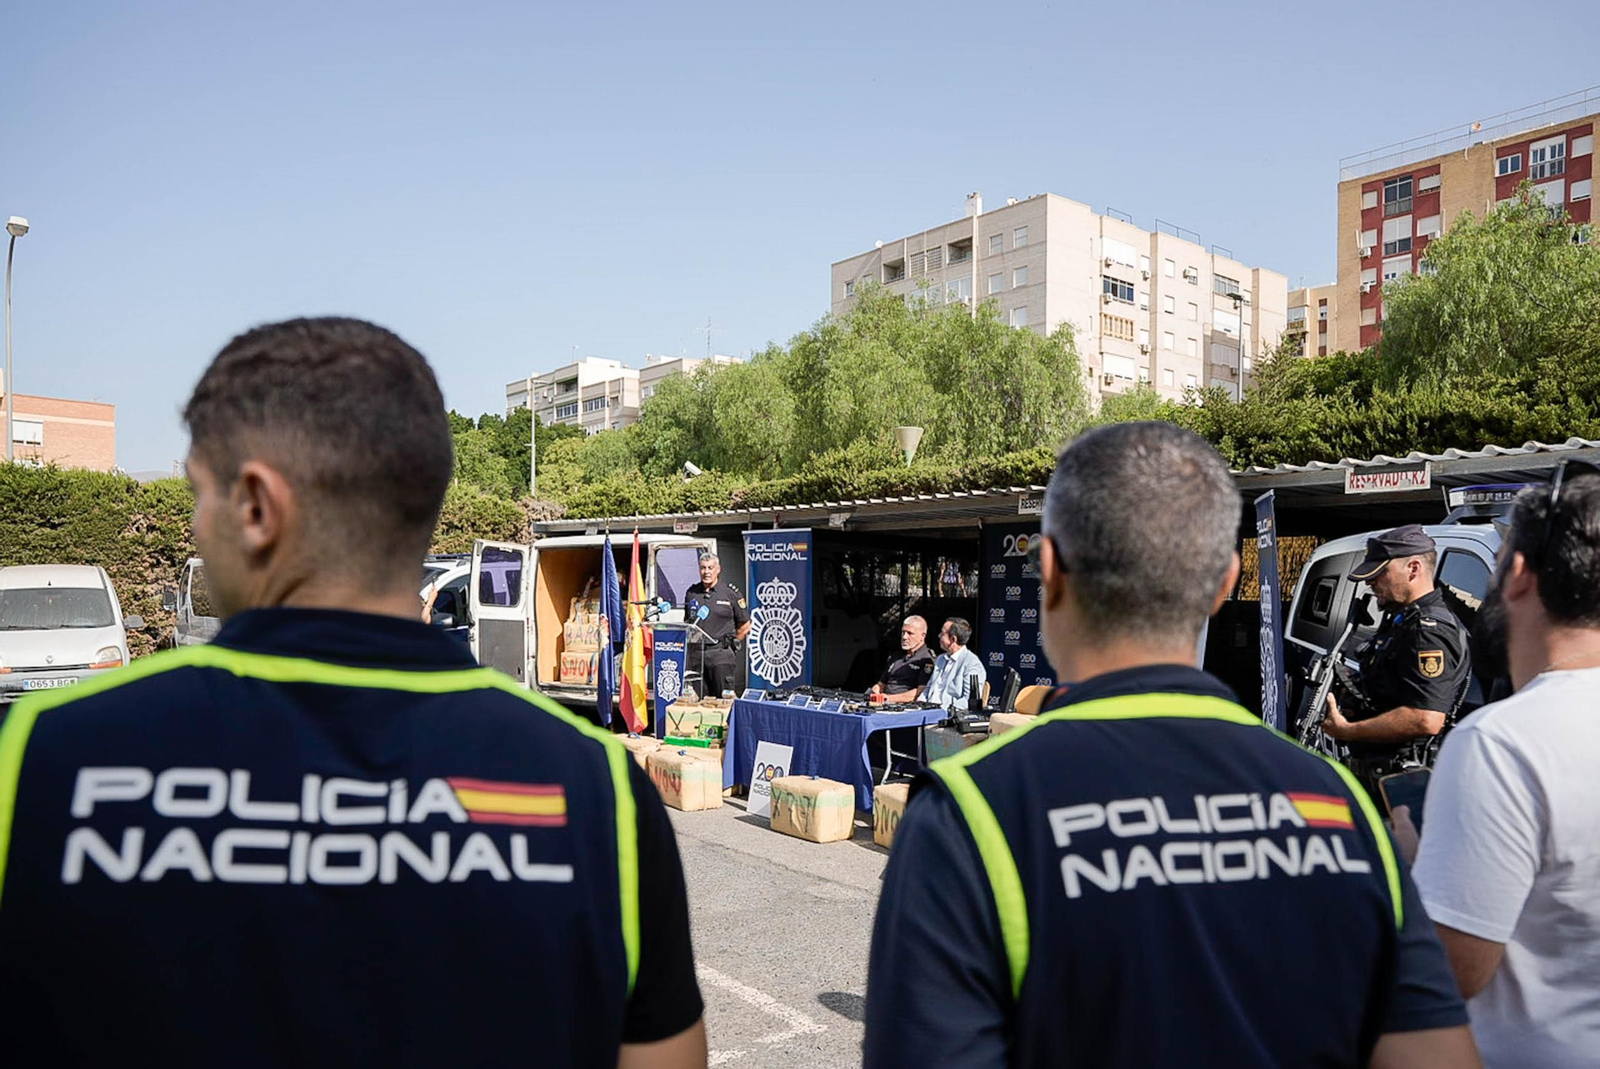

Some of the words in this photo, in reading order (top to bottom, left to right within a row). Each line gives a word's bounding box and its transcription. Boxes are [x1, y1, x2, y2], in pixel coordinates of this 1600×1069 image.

[747, 543, 794, 552] POLICIA
[747, 552, 808, 561] NACIONAL
[30, 680, 55, 688] 0653
[756, 762, 784, 782] 200
[753, 782, 771, 792] POLIC
[753, 788, 771, 797] NACIO
[61, 827, 575, 884] NACIONAL
[1060, 835, 1371, 898] NACIONAL
